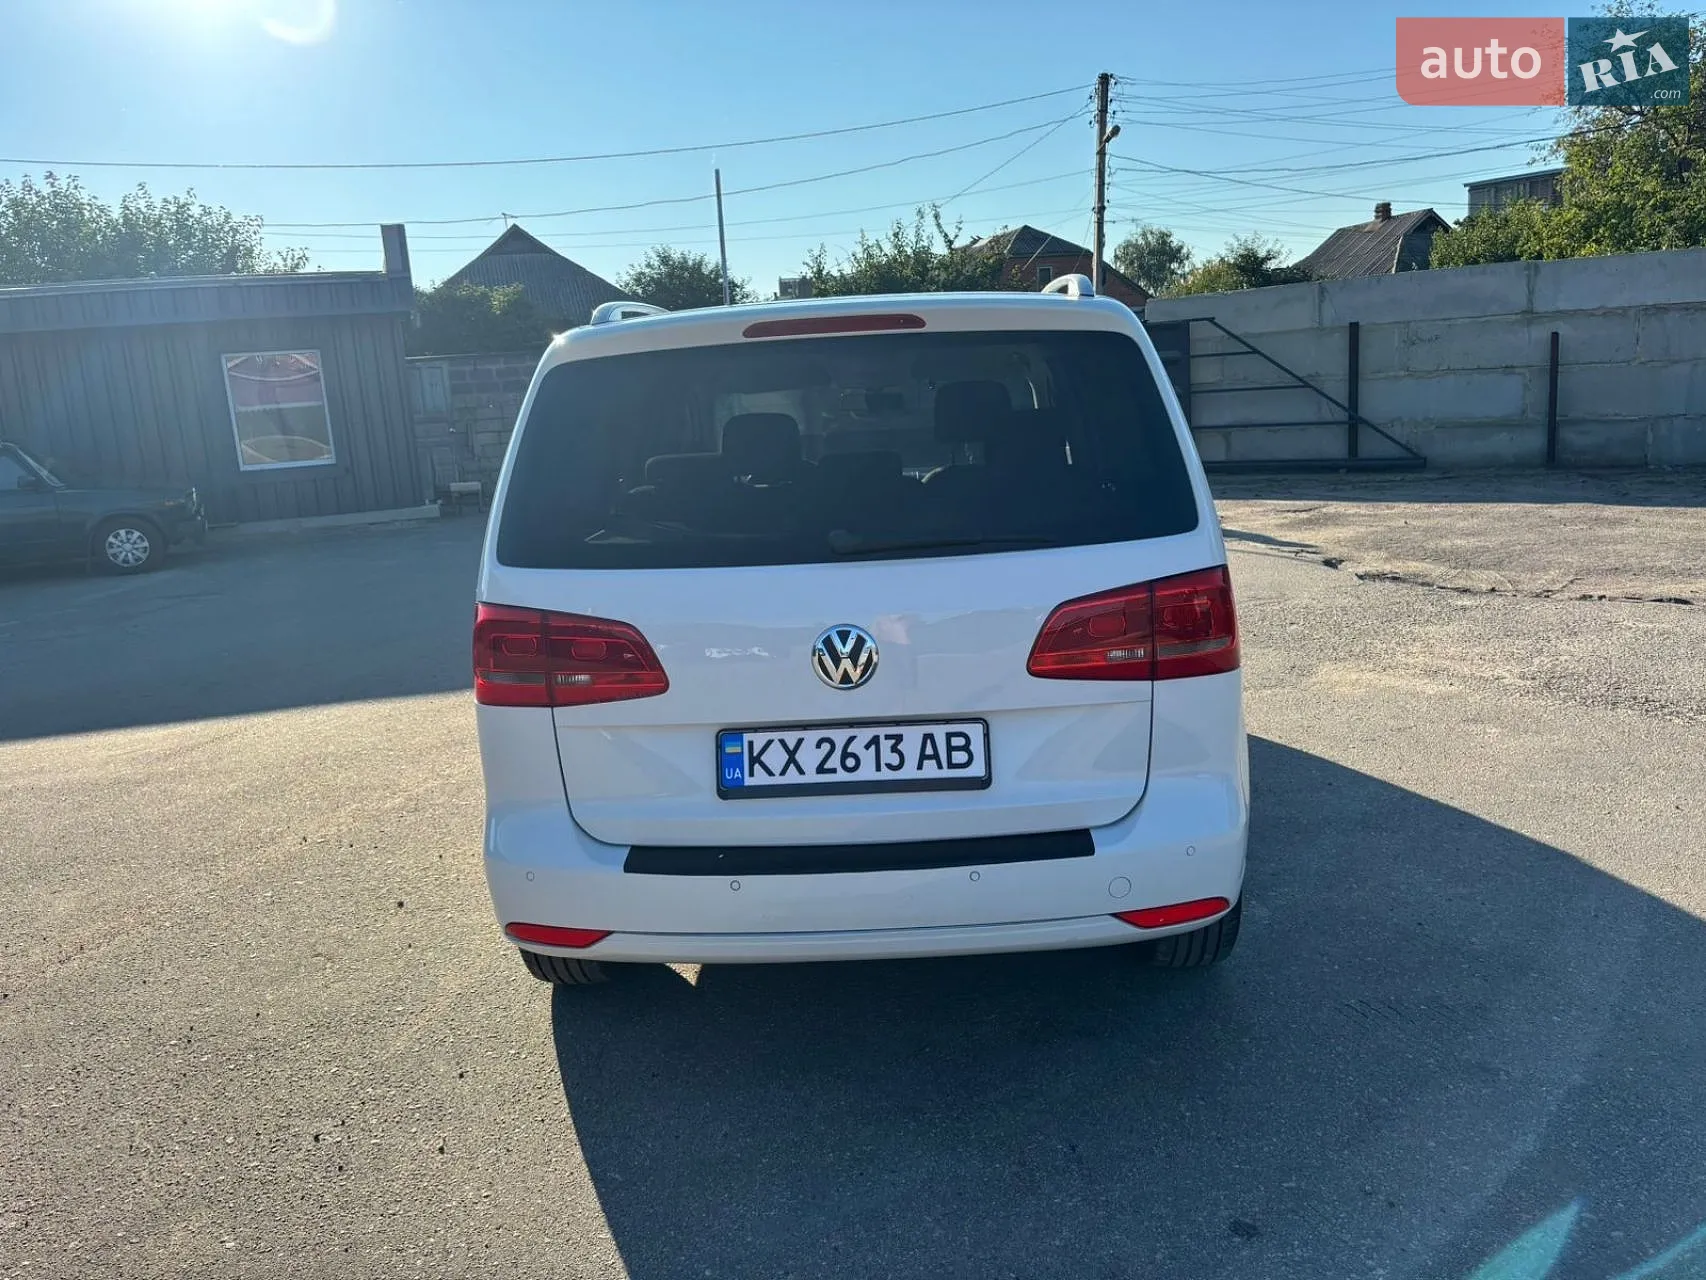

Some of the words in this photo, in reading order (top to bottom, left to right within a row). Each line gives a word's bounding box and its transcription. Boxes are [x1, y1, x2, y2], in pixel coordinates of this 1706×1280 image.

[814, 626, 876, 687] VW
[725, 767, 742, 780] UA
[747, 737, 806, 778] KX
[815, 733, 905, 775] 2613
[916, 731, 975, 771] AB
